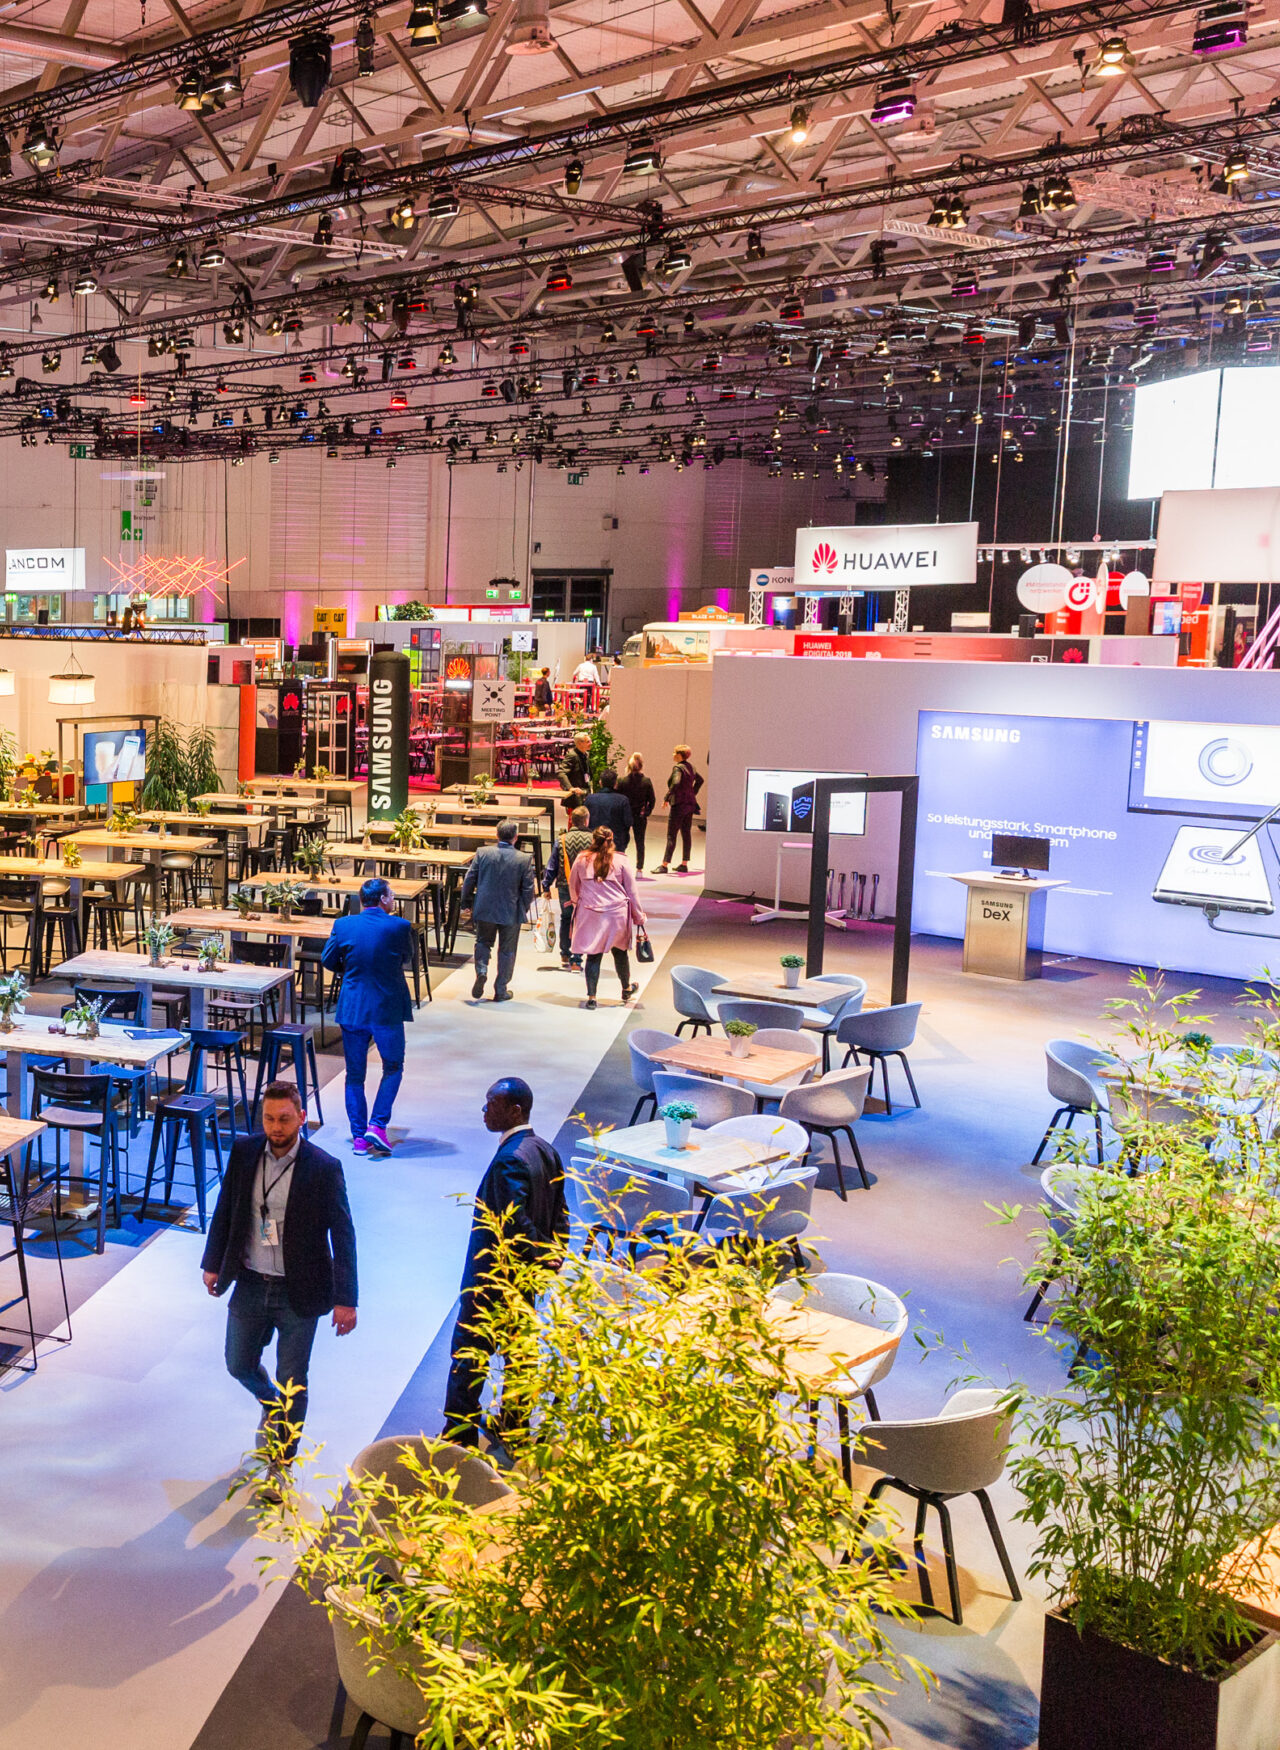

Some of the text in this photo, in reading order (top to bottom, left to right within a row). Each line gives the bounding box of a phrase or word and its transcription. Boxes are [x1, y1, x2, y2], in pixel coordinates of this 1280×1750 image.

[8, 557, 65, 570] ANCOM
[843, 550, 938, 570] HUAWEI
[316, 613, 327, 622] CAT
[333, 613, 344, 622] CAT
[803, 642, 832, 650] HUAWEI
[931, 725, 1021, 743] SAMSUNG
[371, 679, 393, 810] SAMSUNG
[927, 813, 1118, 840] So leistungsstark, Smartphone
[968, 829, 993, 840] und
[981, 899, 1013, 909] SAMSUNG
[983, 907, 1011, 921] DeX
